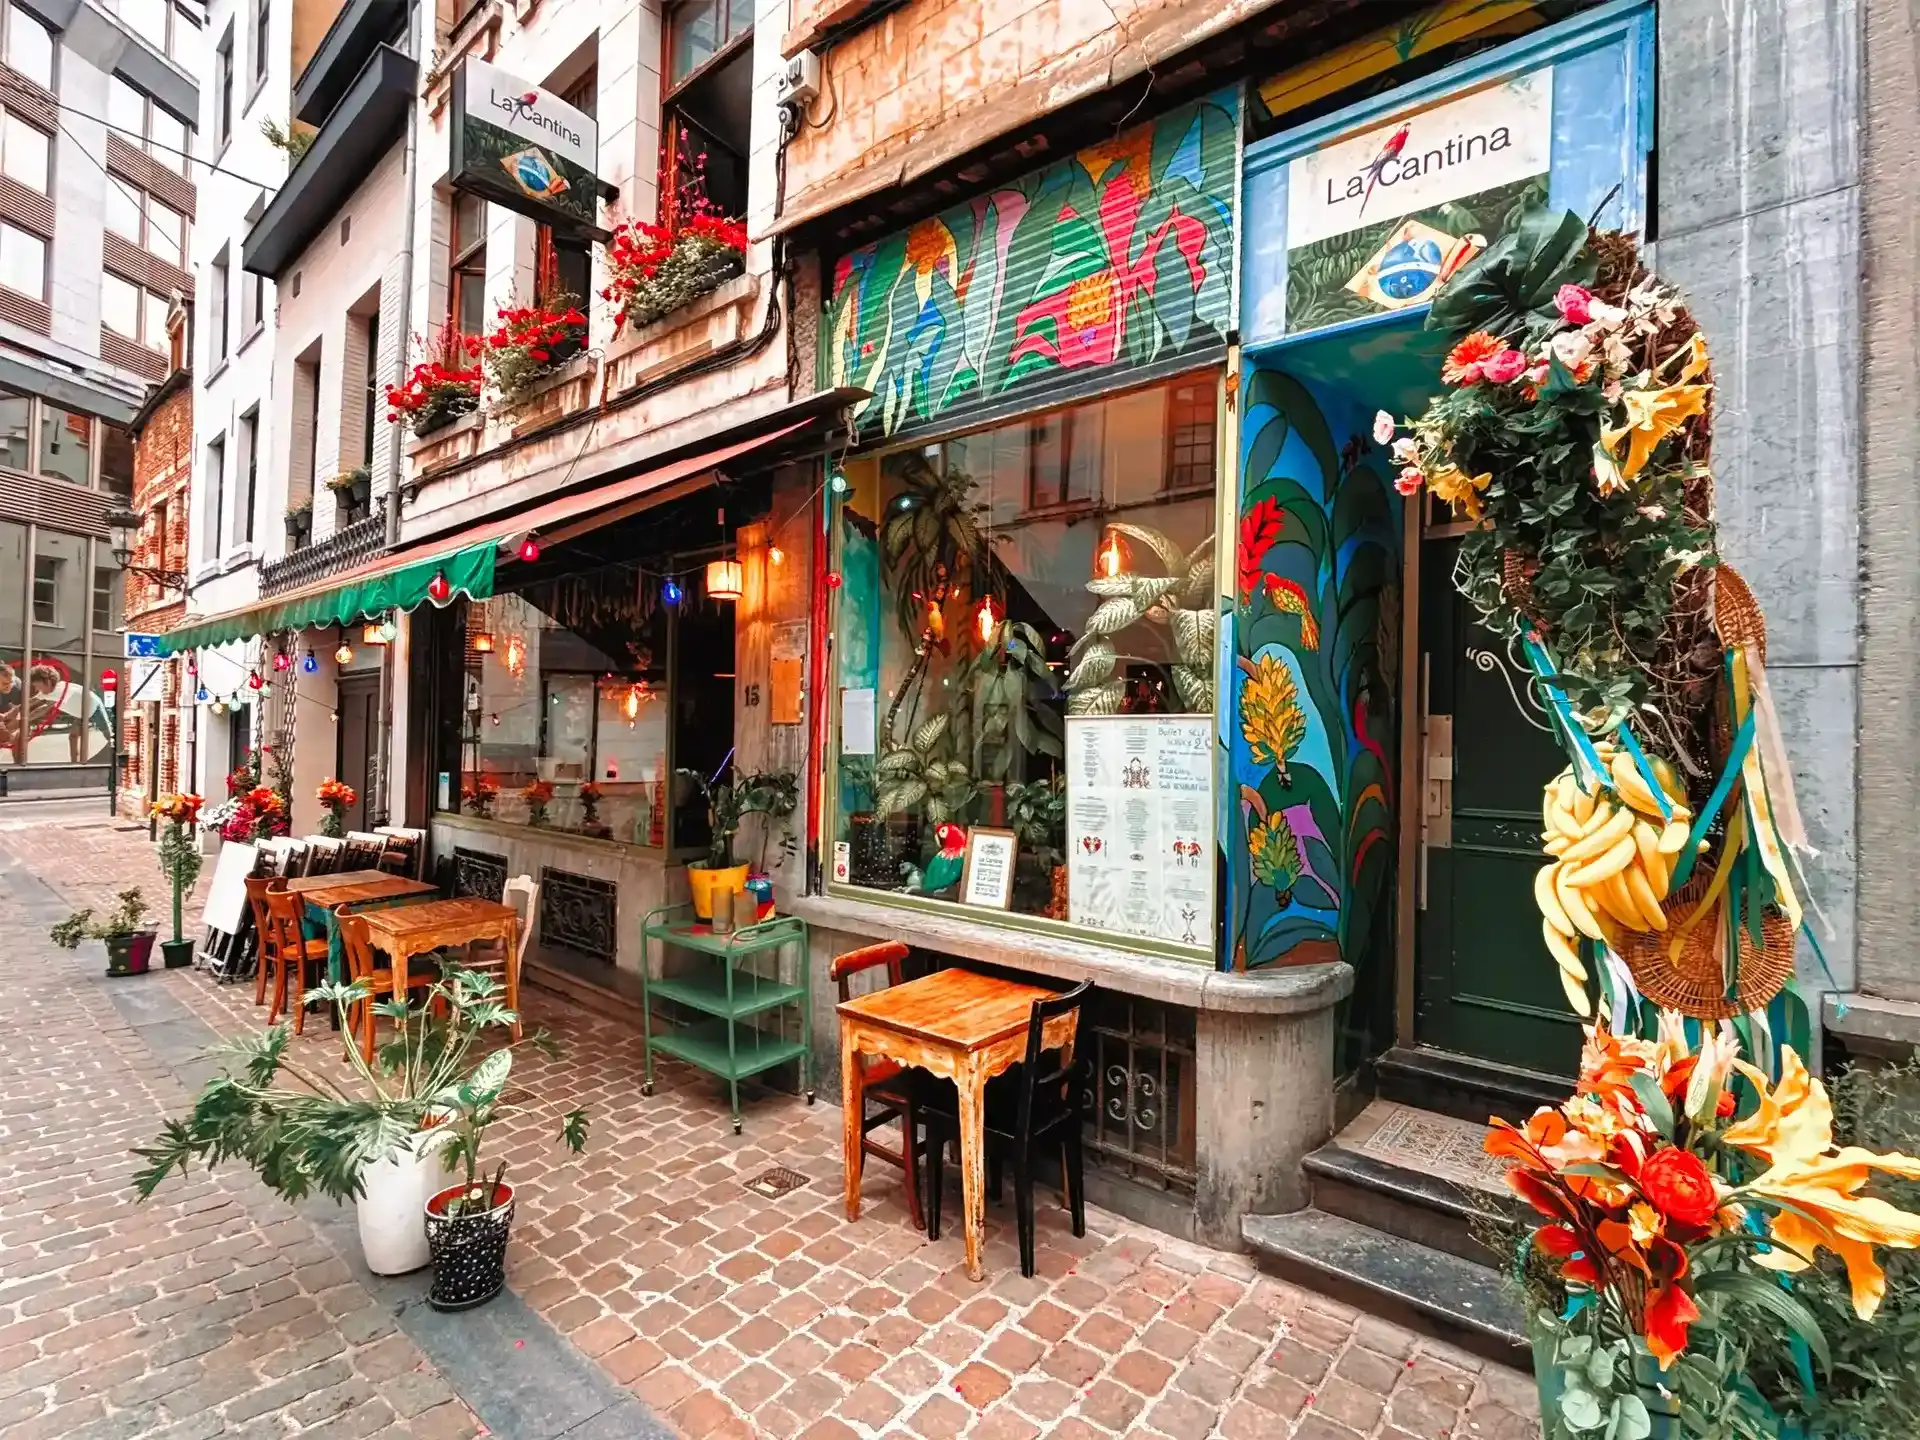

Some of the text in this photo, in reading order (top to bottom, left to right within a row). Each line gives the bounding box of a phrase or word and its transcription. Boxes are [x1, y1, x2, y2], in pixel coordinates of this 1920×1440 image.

[491, 89, 581, 148] La Cantina
[1327, 126, 1512, 205] La Cantina
